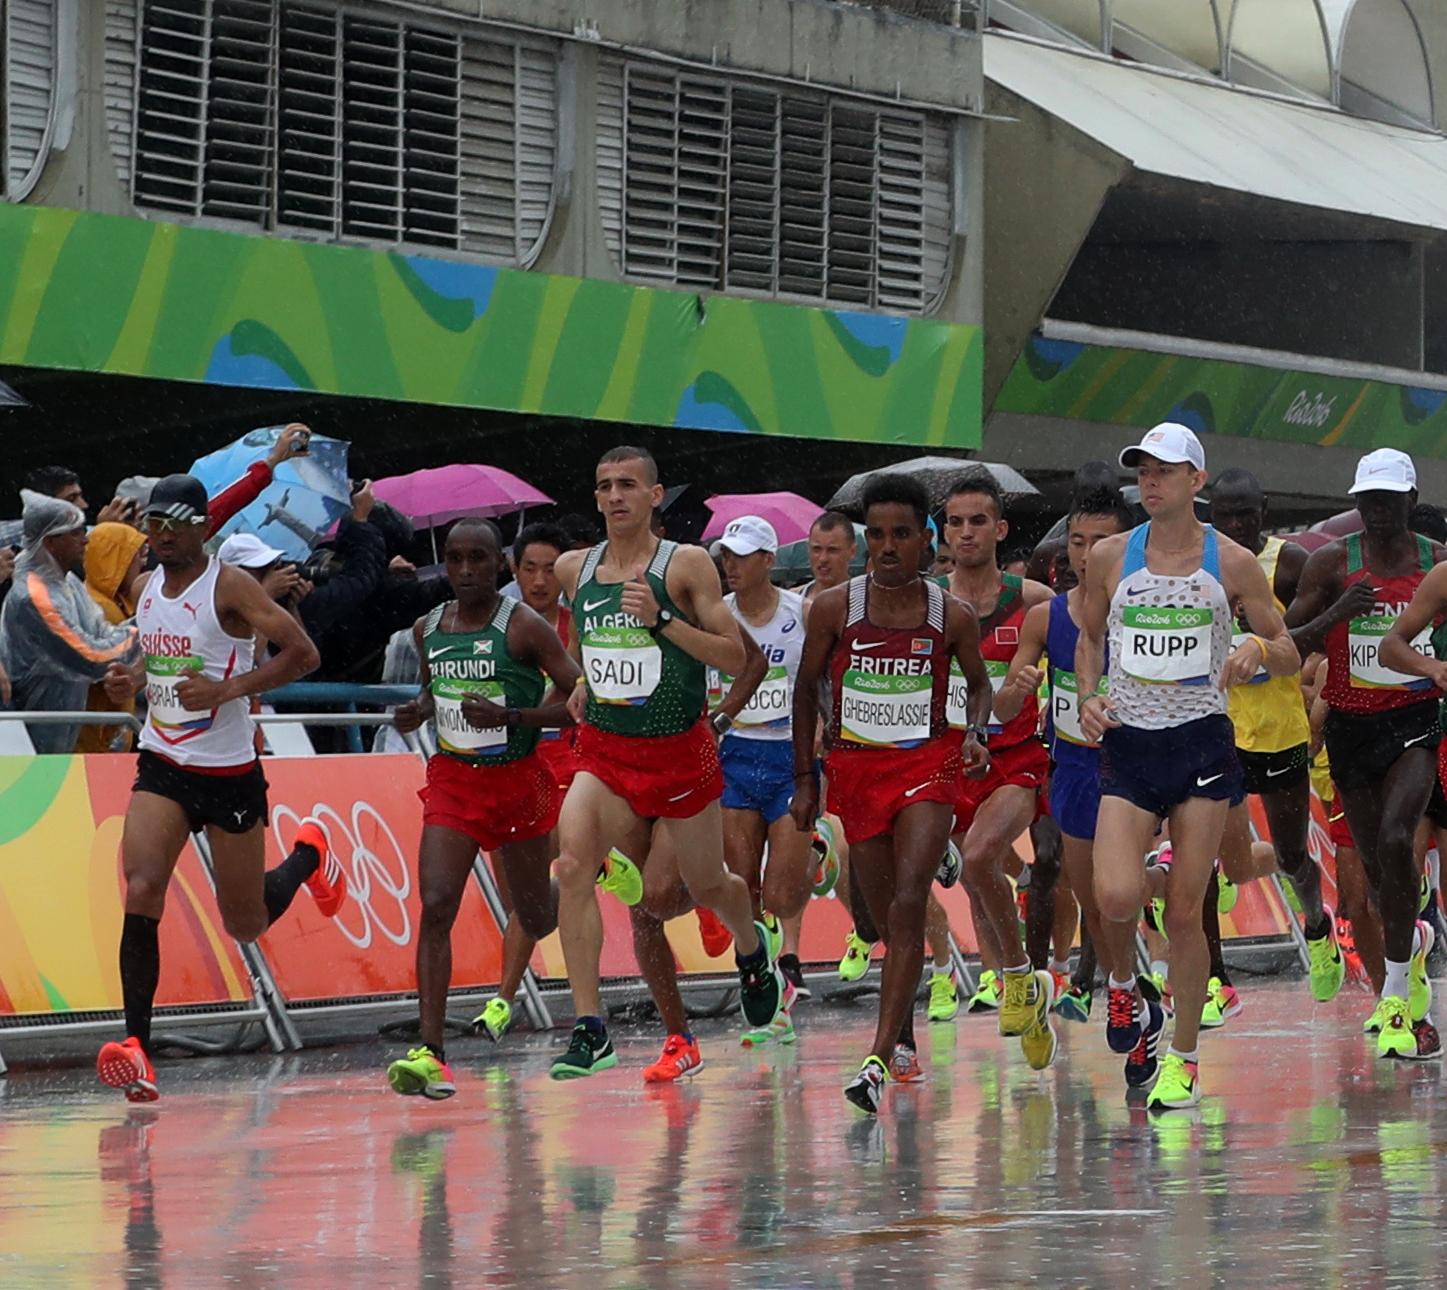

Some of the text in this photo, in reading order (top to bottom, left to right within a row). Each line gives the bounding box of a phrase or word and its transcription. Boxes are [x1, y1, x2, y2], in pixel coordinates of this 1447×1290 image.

[1133, 635, 1198, 657] RUPP
[591, 658, 643, 686] SADI
[850, 654, 932, 676] ERITREA
[843, 696, 929, 726] GHEBRESLASSIE
